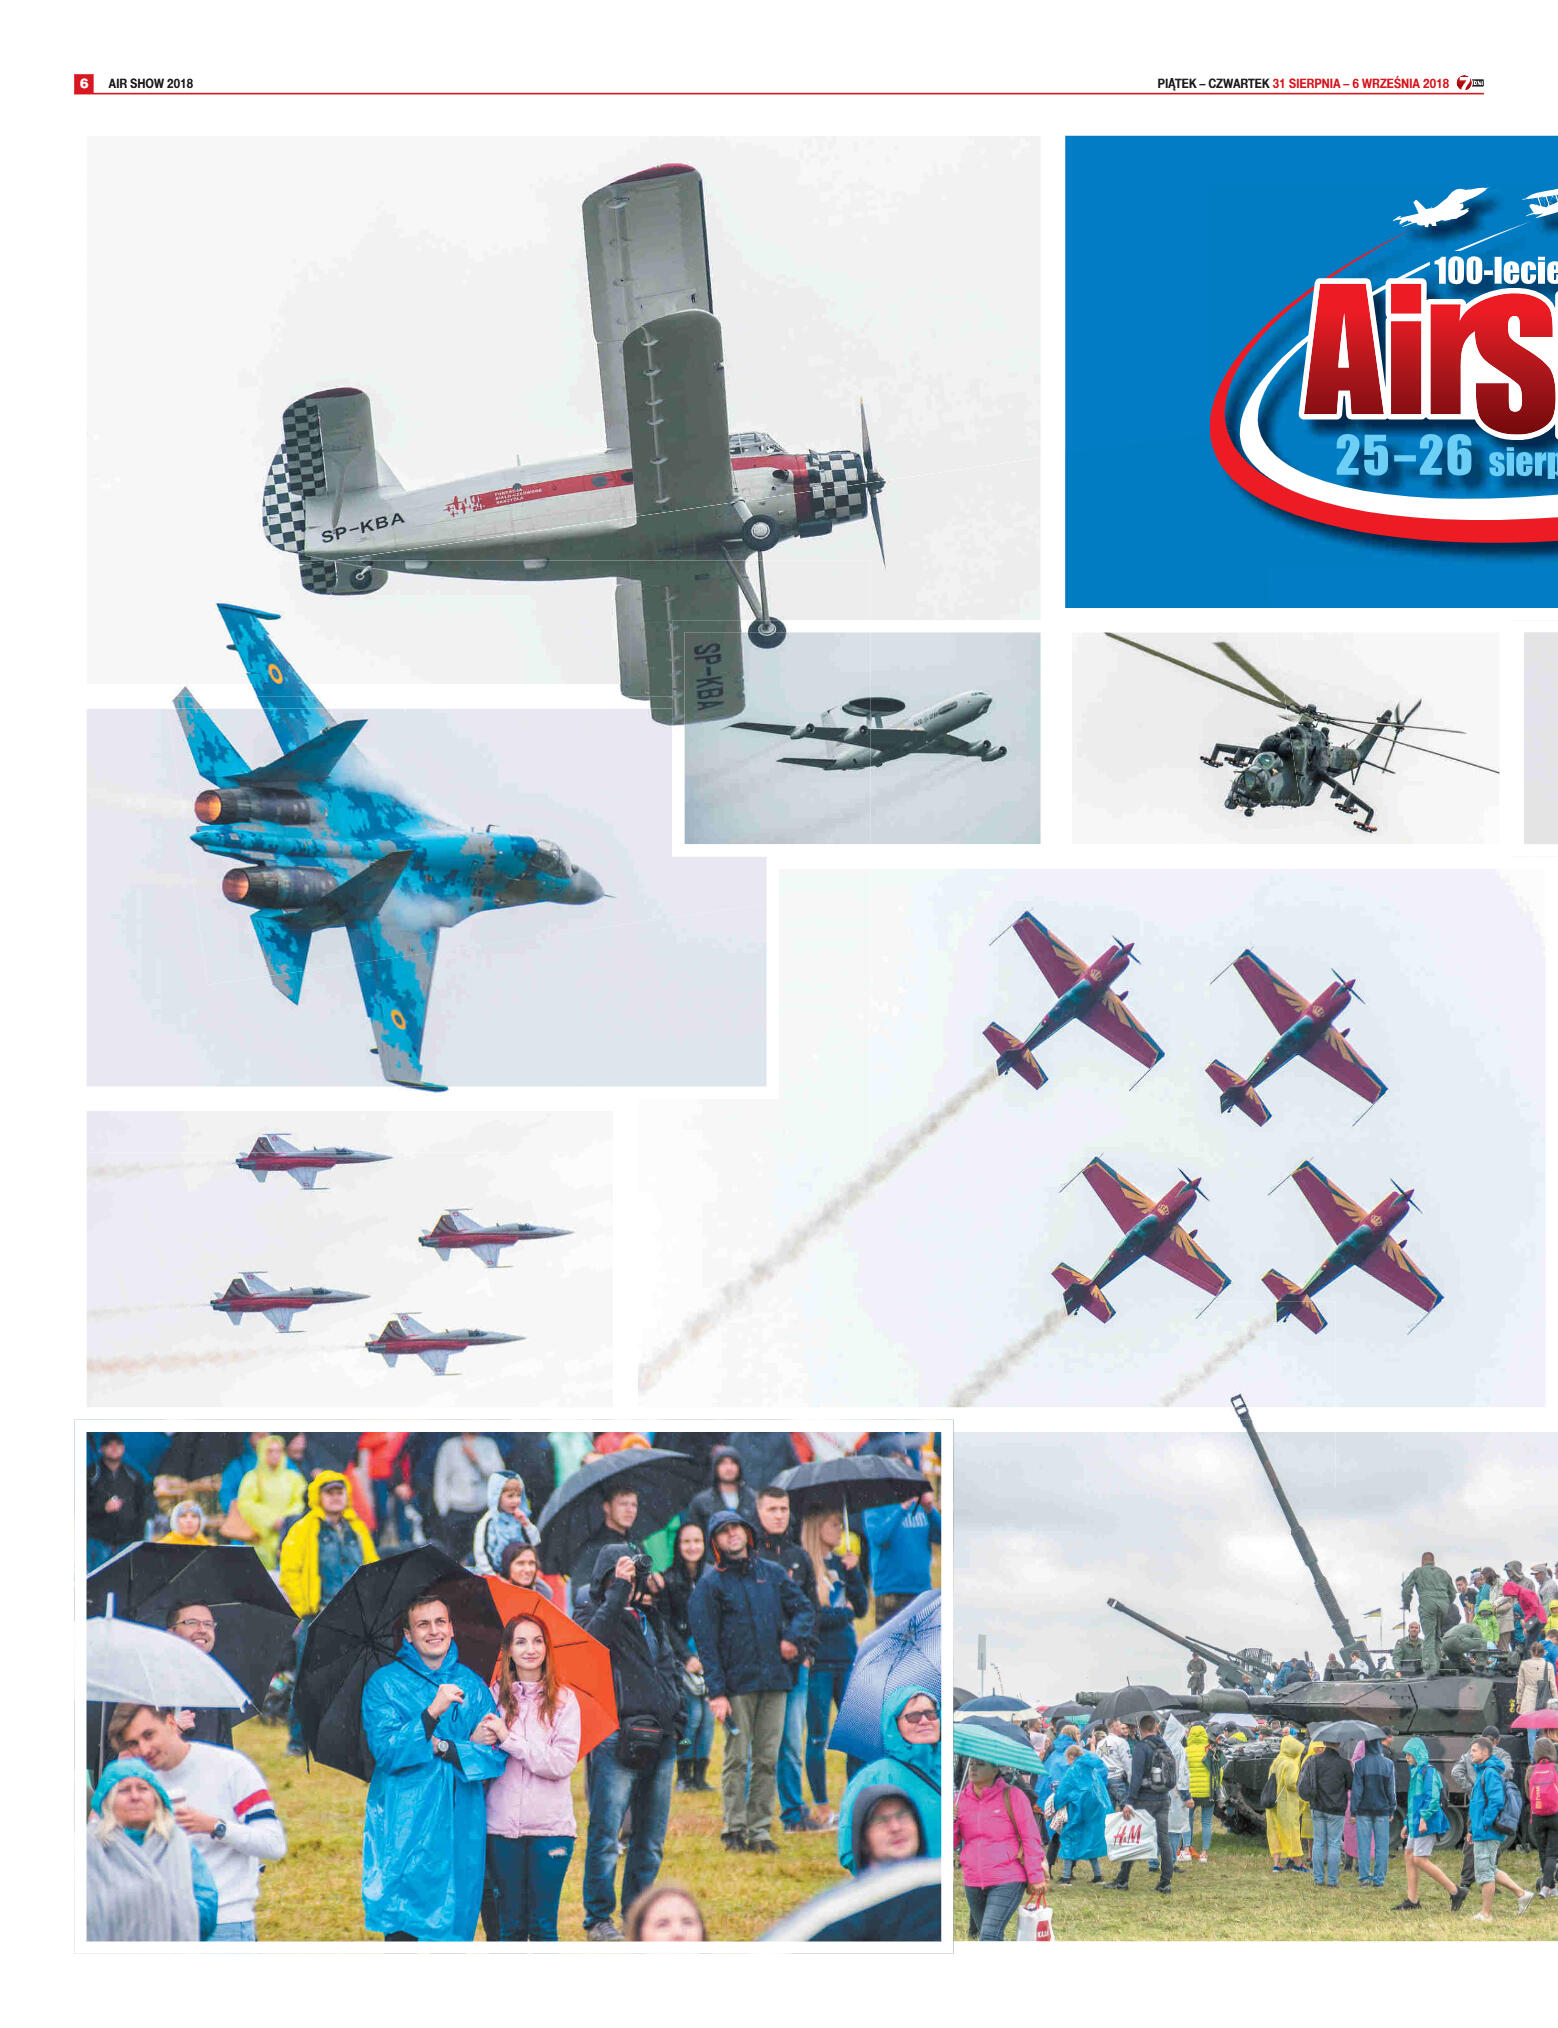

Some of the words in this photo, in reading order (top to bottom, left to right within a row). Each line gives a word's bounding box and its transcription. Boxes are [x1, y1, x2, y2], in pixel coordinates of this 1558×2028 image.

[80, 78, 88, 89] 6
[108, 78, 127, 89] AIR
[130, 78, 164, 89] SHOW
[167, 78, 193, 89] 2018
[1157, 78, 1197, 91] PIĄTEK
[1208, 78, 1270, 89] CZWARTEK
[1273, 78, 1284, 89] 31
[1288, 78, 1341, 89] SIERPNIA
[1352, 78, 1359, 89] 6
[1362, 75, 1420, 89] WRZEŚNIA
[1423, 78, 1449, 89] 2018
[1434, 256, 1558, 285] 100-lecie
[321, 512, 406, 544] SP-KBA
[693, 642, 725, 712] SP-KBA
